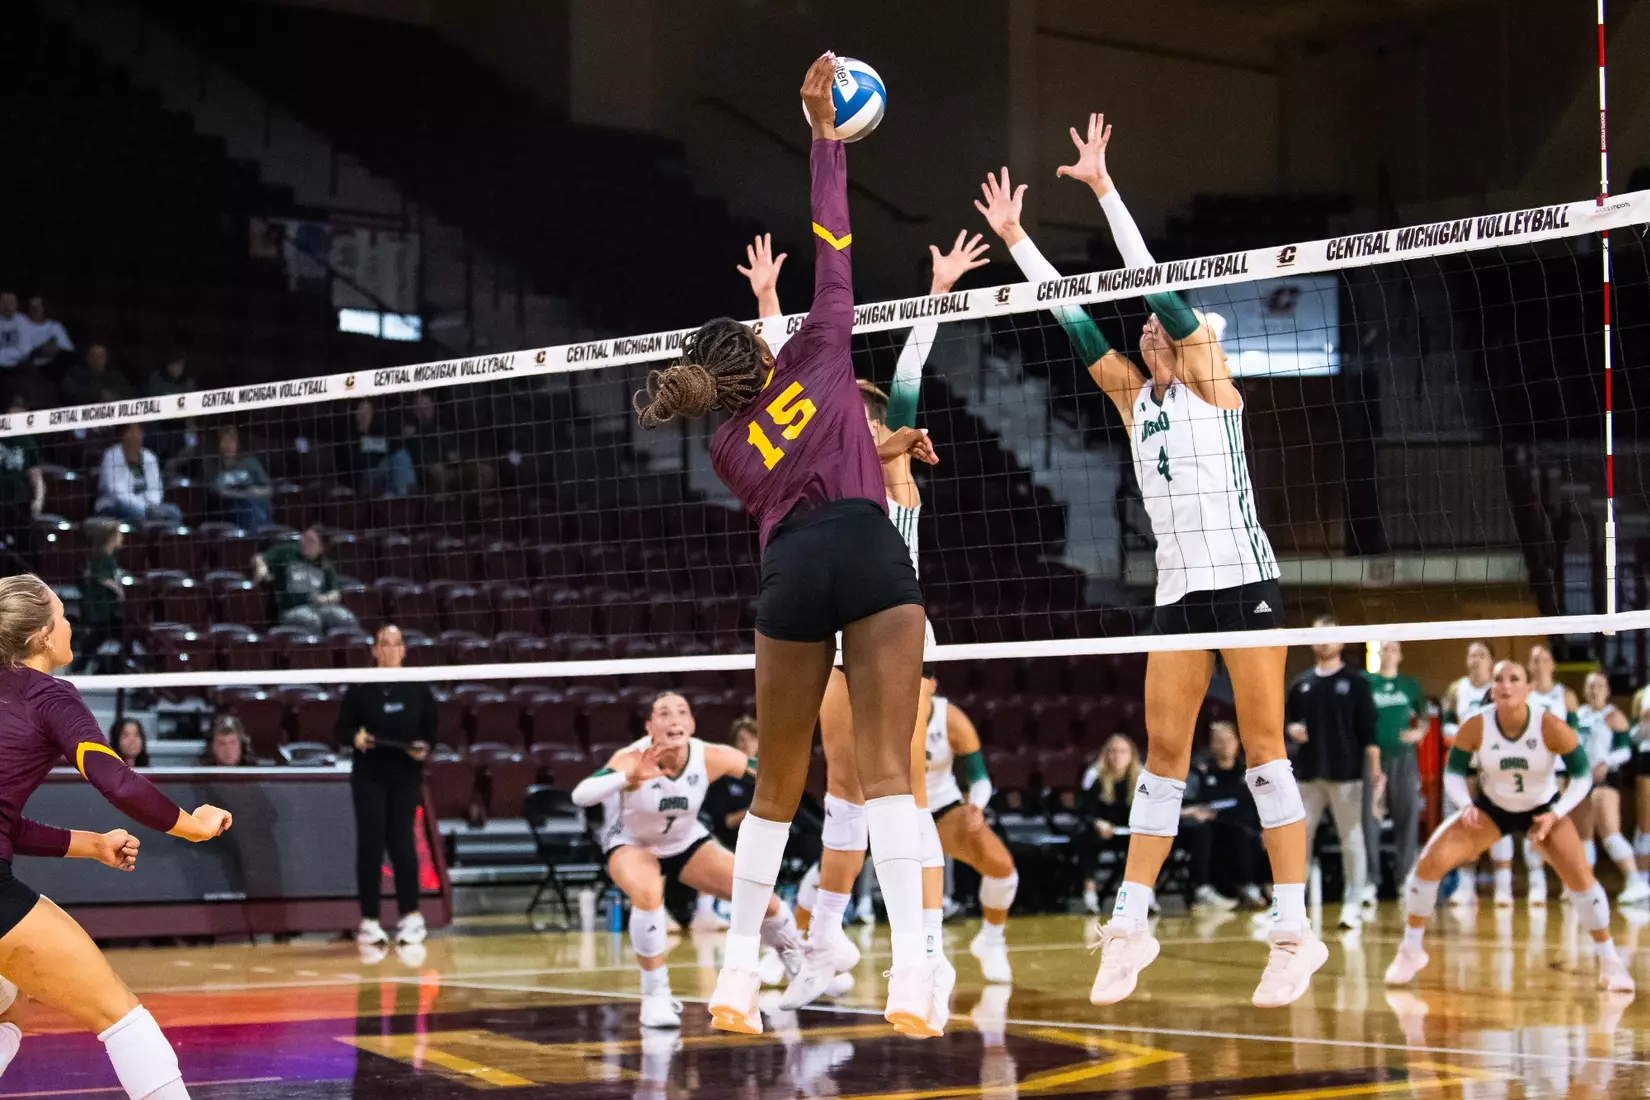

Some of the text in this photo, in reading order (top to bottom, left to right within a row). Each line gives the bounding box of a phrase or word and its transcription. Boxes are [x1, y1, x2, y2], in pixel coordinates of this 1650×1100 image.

[1326, 205, 1569, 262] CENTRAL MICHIGAN VOLLEYBALL
[1037, 252, 1249, 302] CENTRAL MICHIGAN VOLLEYBALL
[853, 292, 970, 326] CHIGAN VOLLEYBALL
[566, 343, 609, 363] CENTRAL
[612, 335, 662, 357] MICHIGAN
[374, 355, 515, 387] CENTRAL MICHIGAN VOLLEYBALL
[202, 379, 327, 407] CENTRAL MICHIGAN VOLLEYBALL
[50, 400, 161, 425] CENTRAL MICHIGAN VOLLEYBALL
[746, 380, 818, 472] 15
[1157, 445, 1173, 482] 4
[1513, 773, 1523, 792] 3
[663, 816, 676, 834] 7
